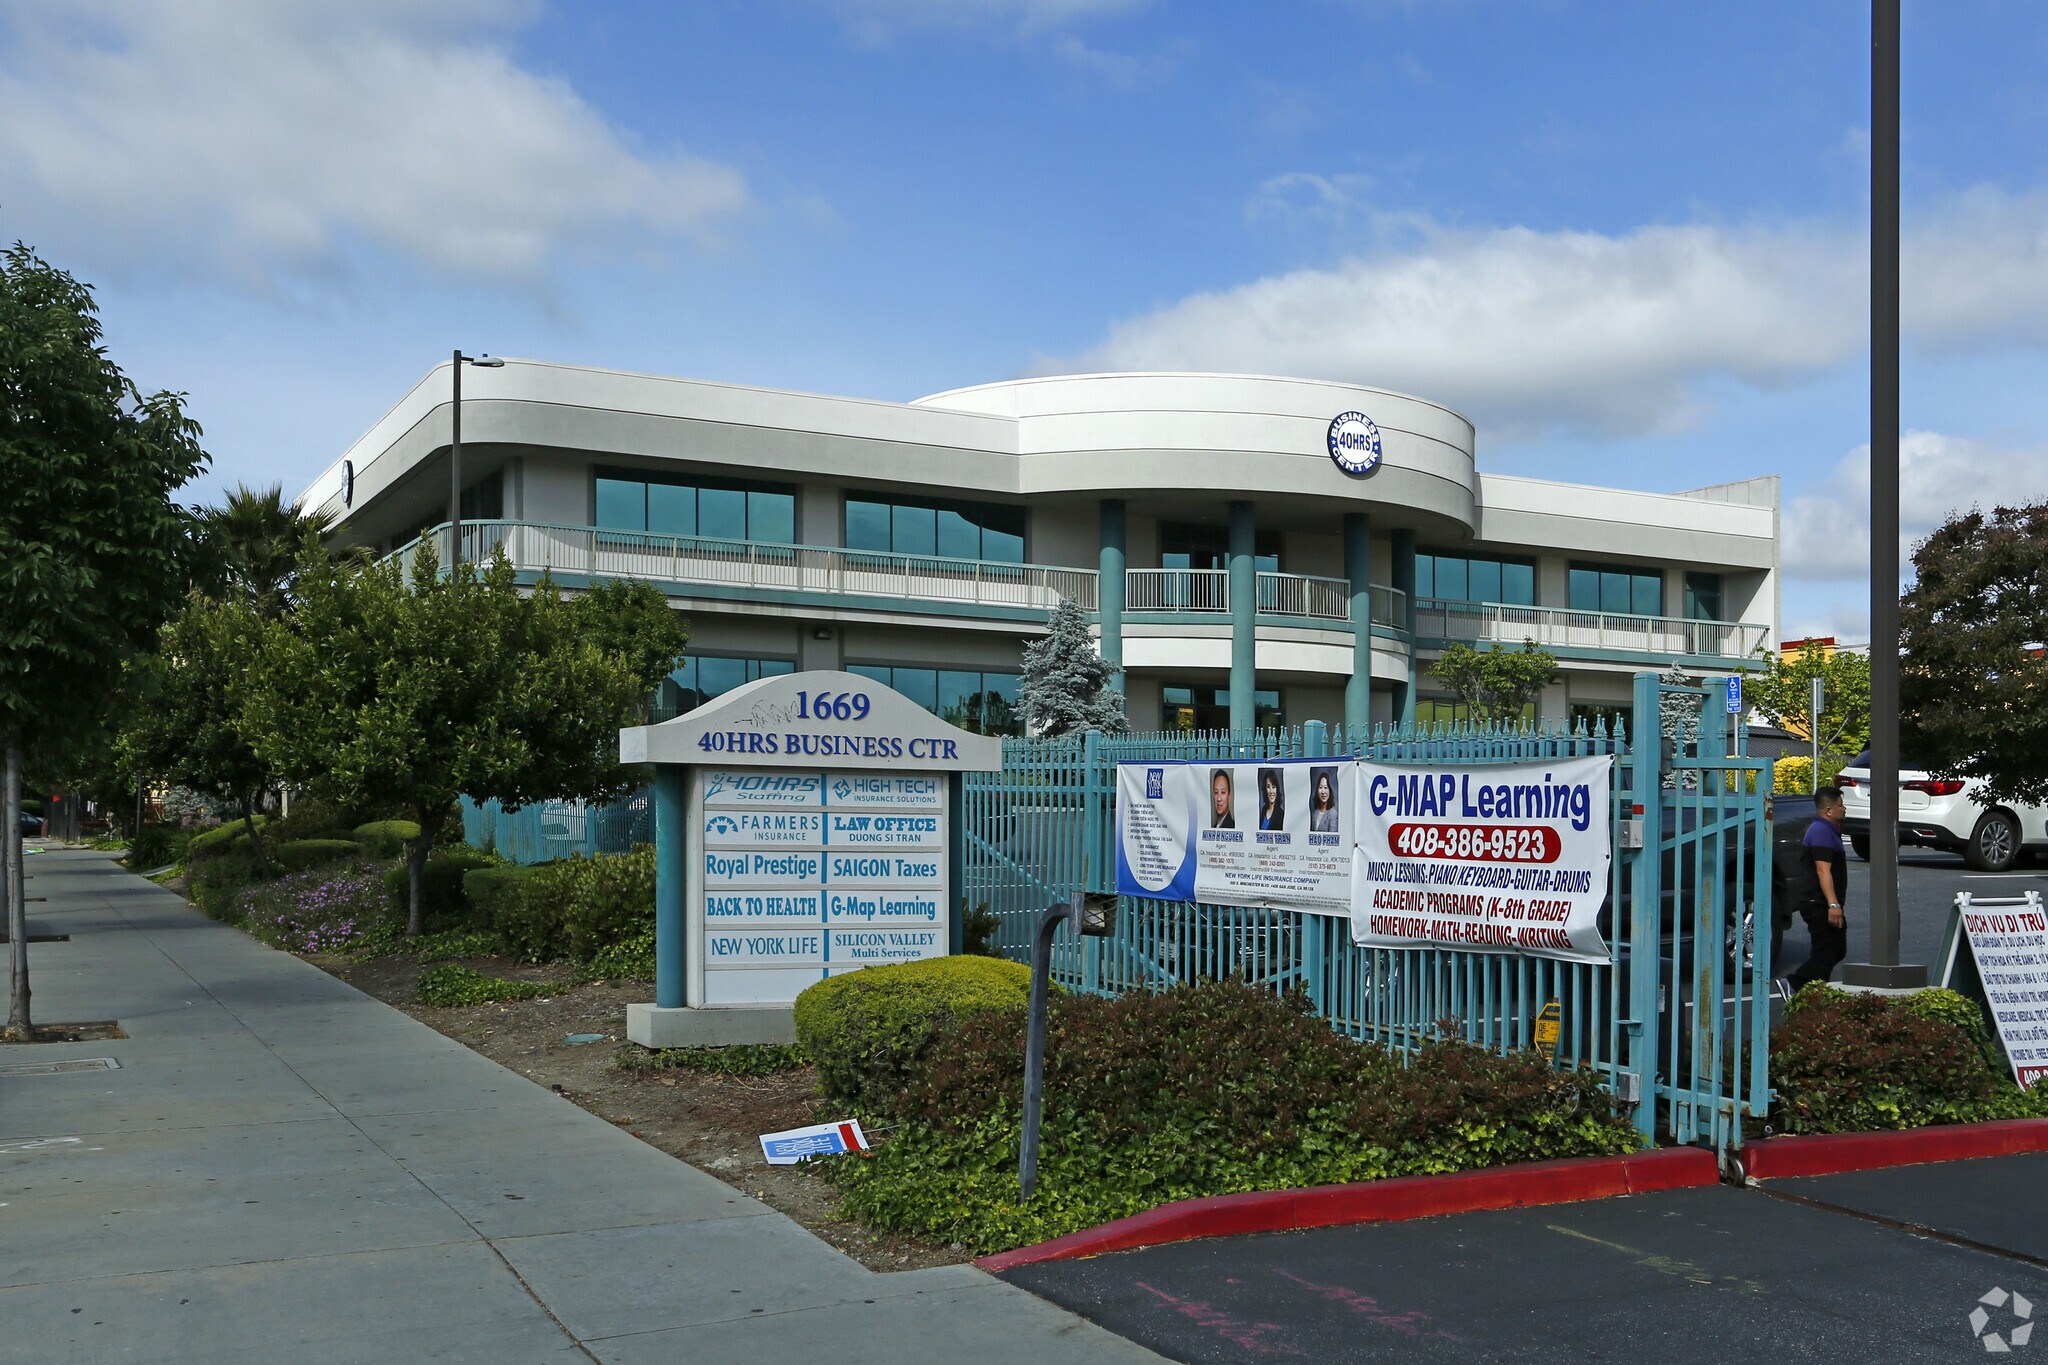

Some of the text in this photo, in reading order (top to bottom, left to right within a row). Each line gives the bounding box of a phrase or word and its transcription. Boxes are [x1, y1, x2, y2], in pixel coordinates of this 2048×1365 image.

[1330, 412, 1380, 443] BUSINESS
[1340, 432, 1371, 452] 40HRS
[1332, 446, 1379, 472] CENTER
[796, 690, 870, 721] 1669
[698, 732, 958, 760] 40HRS BUSINESS CTR
[725, 776, 820, 792] 40HRS
[1149, 772, 1162, 781] NEW
[854, 778, 936, 794] HIGH TECH
[1149, 788, 1162, 797] LIFE
[736, 792, 806, 802] Staffing
[854, 795, 937, 804] INSURANCE SOLUTIONS
[1370, 773, 1591, 832] G-MAP Learning
[742, 815, 819, 830] FARMERS
[834, 817, 937, 832] LAW OFFICE
[754, 832, 806, 841] INSURANCE
[849, 834, 922, 843] DUONG SI TRAN
[1308, 834, 1340, 846] HAO PHAM
[1398, 826, 1546, 860] 408-386-9523
[706, 854, 818, 880] Royal Prestige
[834, 858, 938, 878] SAIGON Taxes
[1366, 862, 1394, 882] MUSIC
[1263, 874, 1293, 883] INSURANCE
[706, 898, 817, 916] BACK TO HEALTH
[831, 895, 936, 922] G-Map Learning
[1372, 888, 1424, 912] ACADEMIC
[1427, 892, 1484, 917] PROGRAMS
[1486, 896, 1526, 922] (K-8th
[1528, 900, 1572, 927] GRADE)
[1988, 915, 2006, 936] VỤ
[2005, 915, 2021, 932] DI
[2019, 907, 2046, 931] TRÚ
[712, 938, 818, 956] NEW YORK LIFE
[834, 934, 936, 947] SILICON VALLEY
[851, 948, 922, 958] Multi Services
